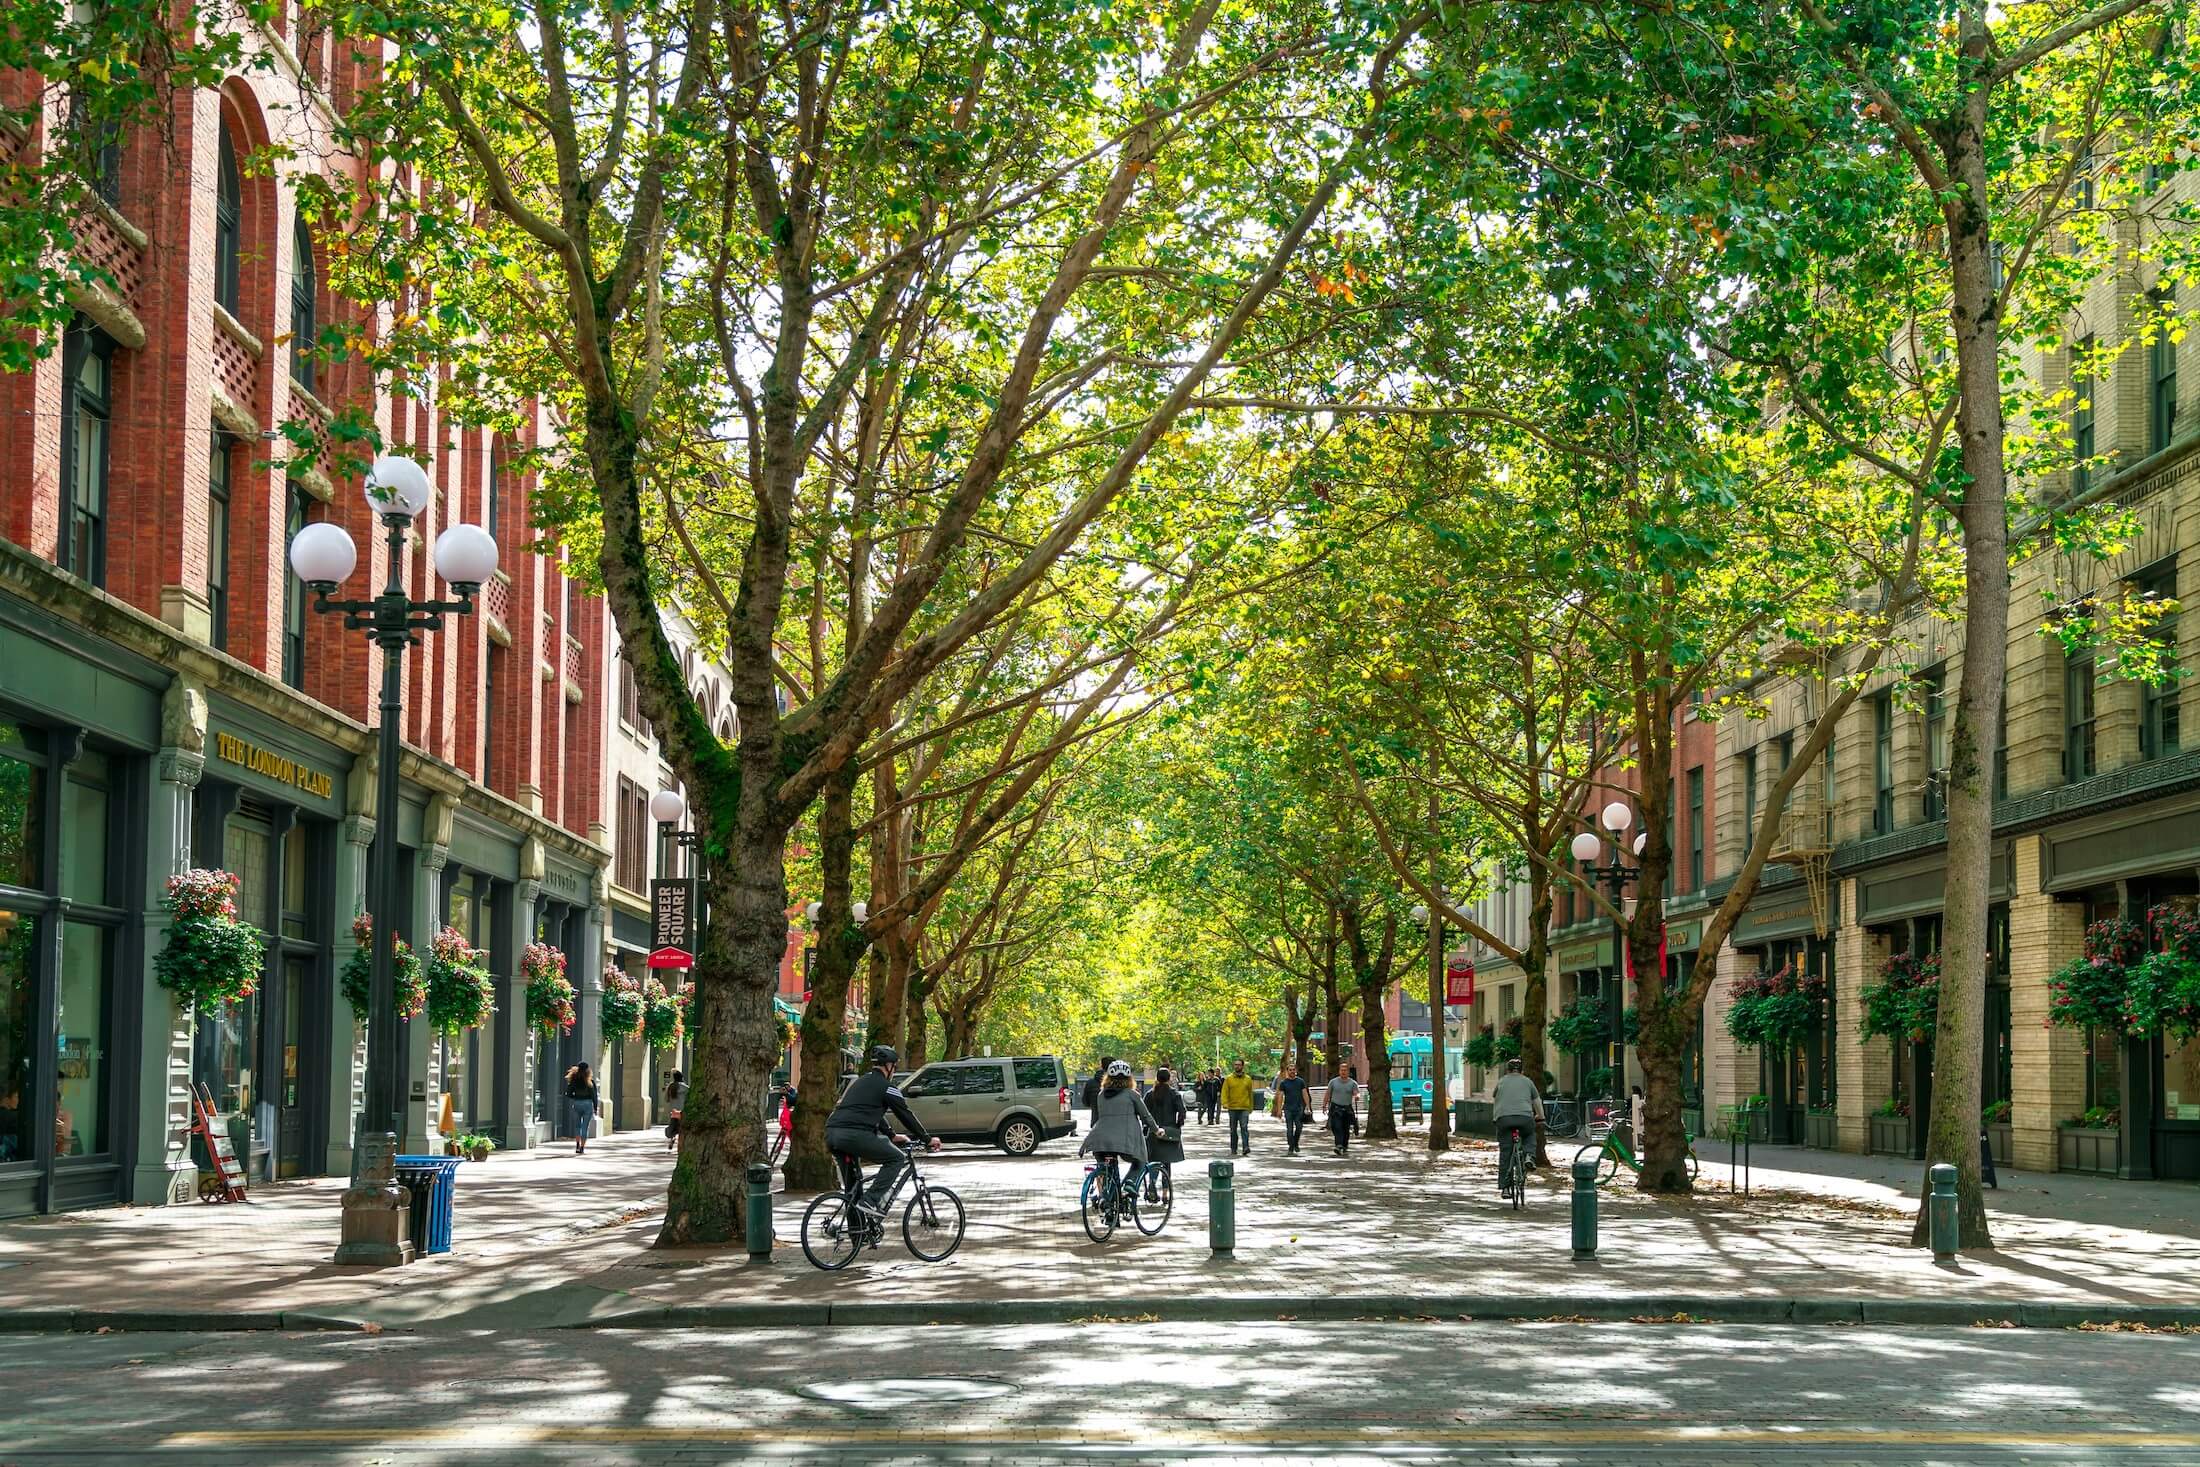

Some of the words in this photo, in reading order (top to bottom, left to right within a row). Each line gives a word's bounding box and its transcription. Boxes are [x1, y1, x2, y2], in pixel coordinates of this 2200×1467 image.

[217, 731, 246, 766] THE
[246, 743, 295, 785] LONDON
[296, 763, 333, 800] PLANE
[657, 886, 672, 945] PIONEER
[671, 886, 686, 945] SQUARE
